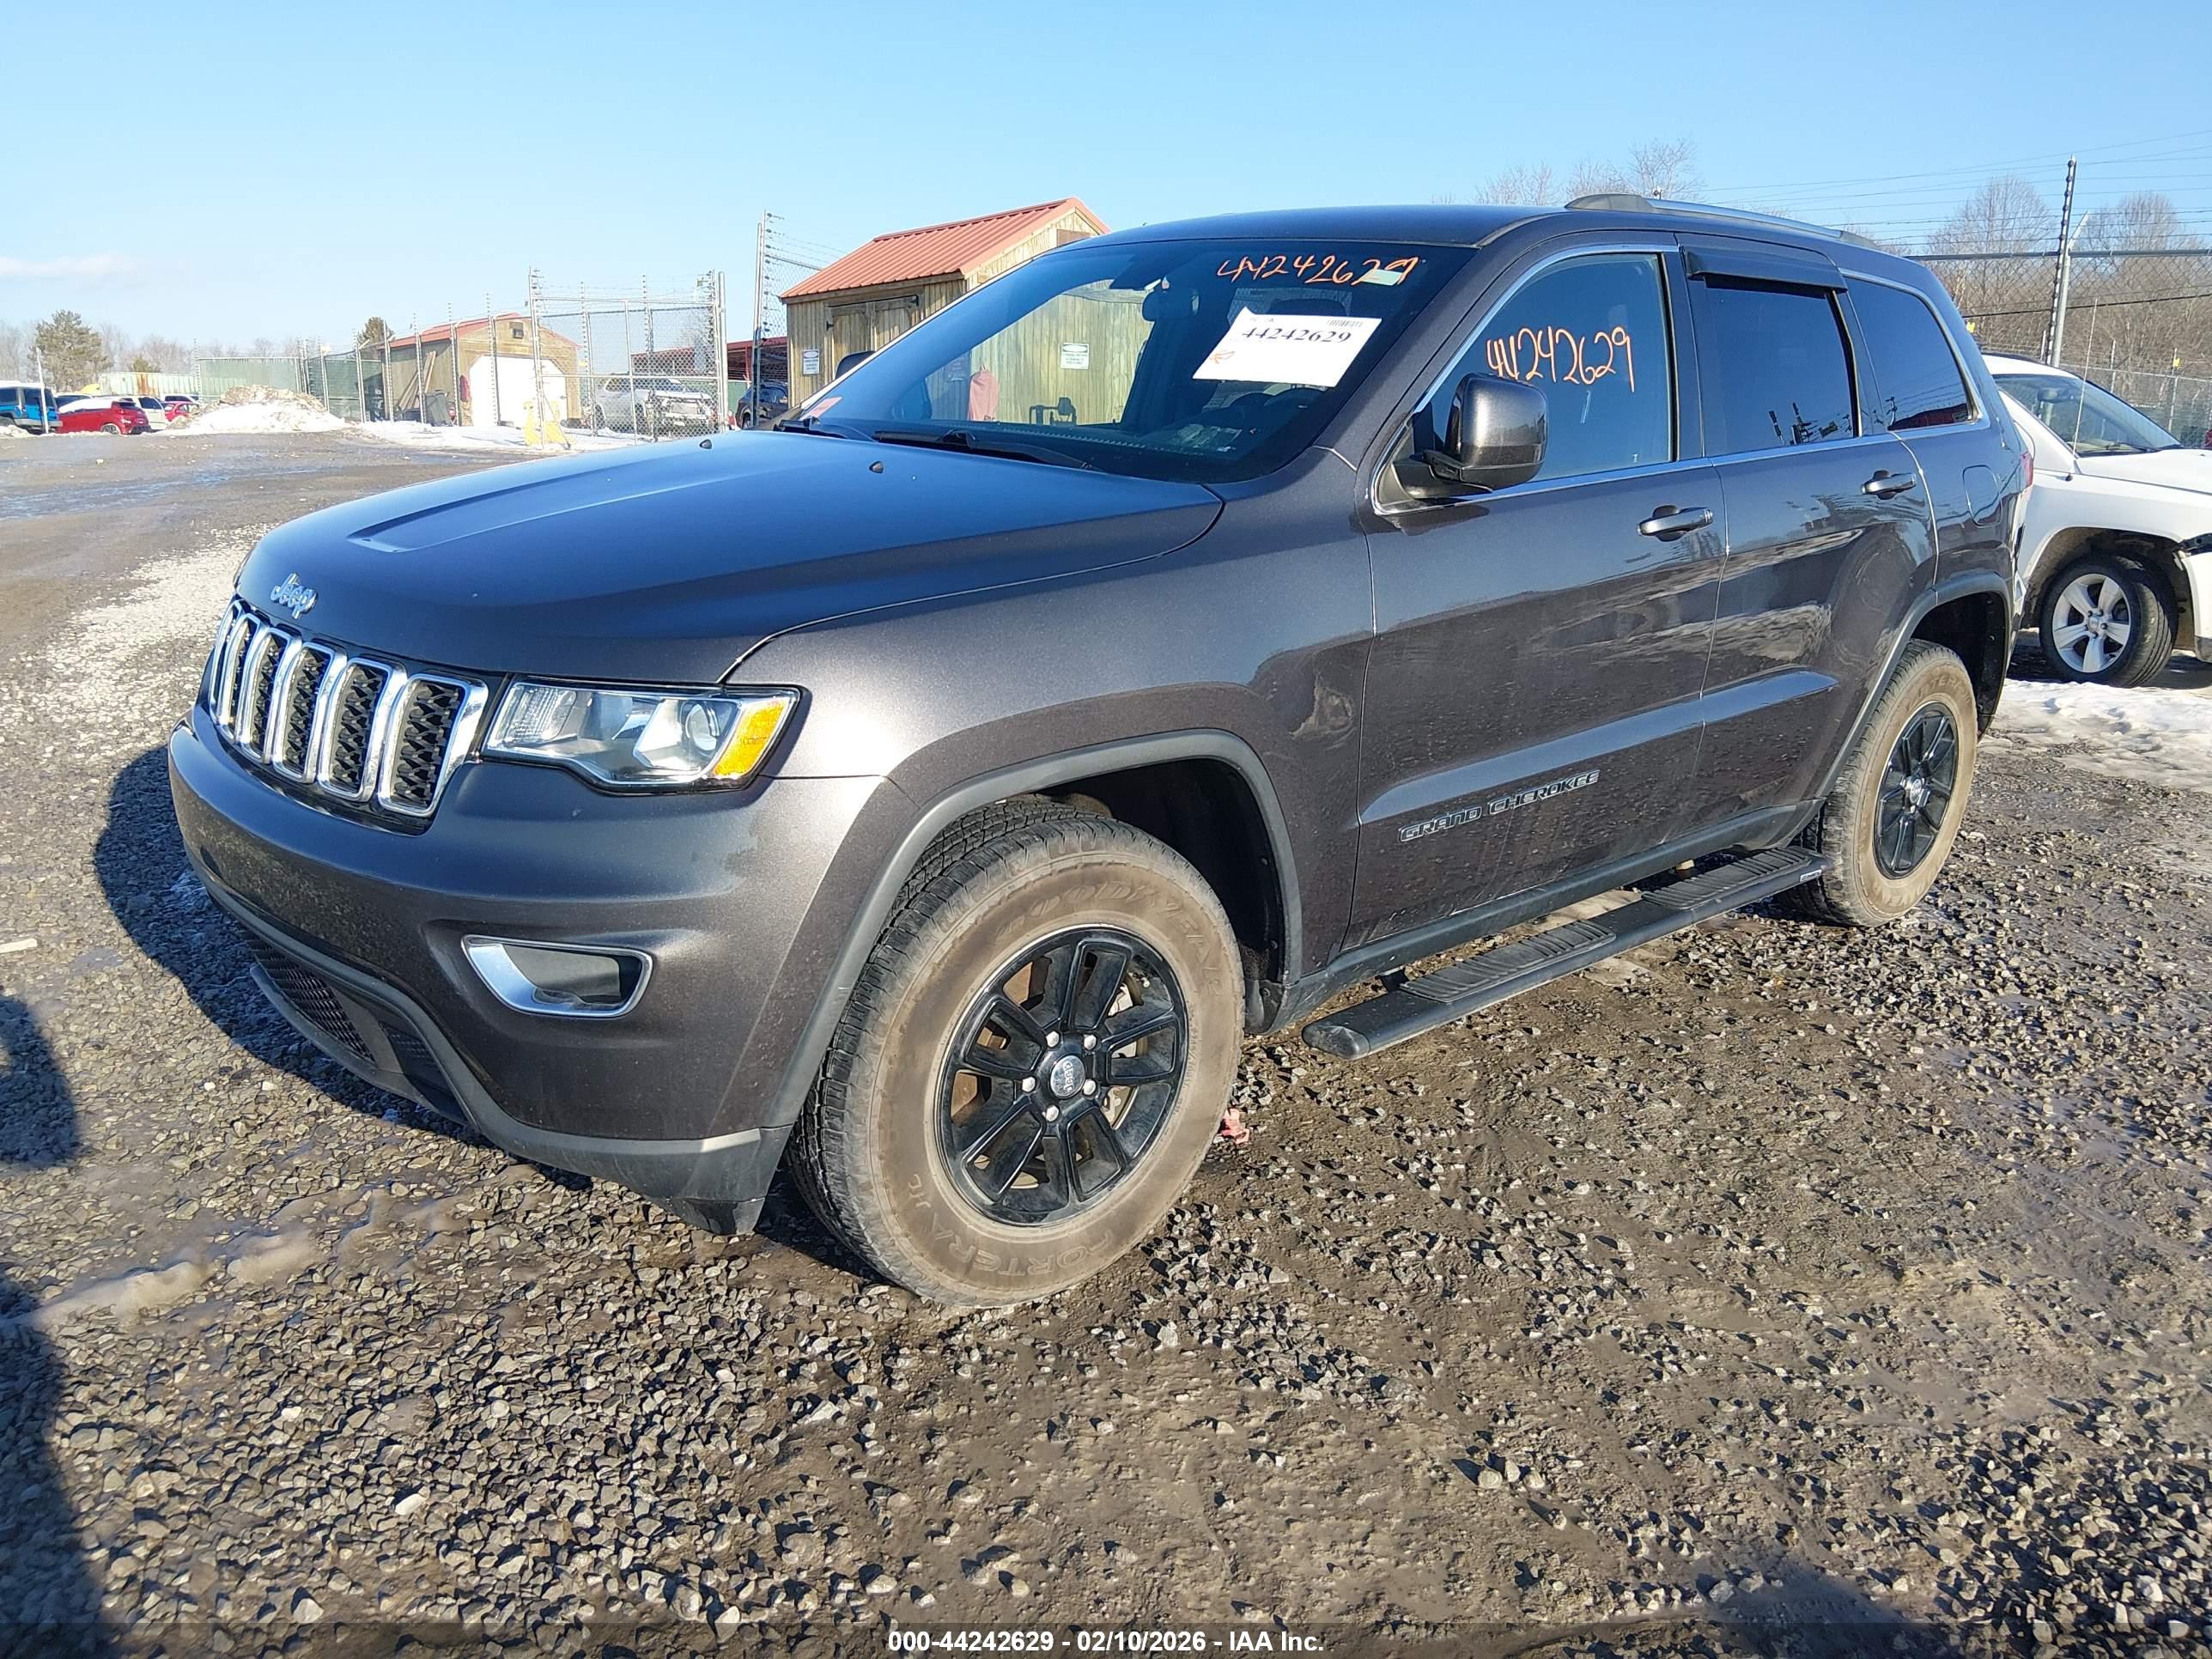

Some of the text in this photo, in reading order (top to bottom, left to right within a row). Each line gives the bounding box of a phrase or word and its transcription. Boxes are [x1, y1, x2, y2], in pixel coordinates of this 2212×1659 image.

[1242, 326, 1352, 343] 44242629
[1486, 325, 1635, 393] 44242629
[270, 572, 318, 619] Jeep
[1397, 769, 1601, 842] GRAND CHEROKEE
